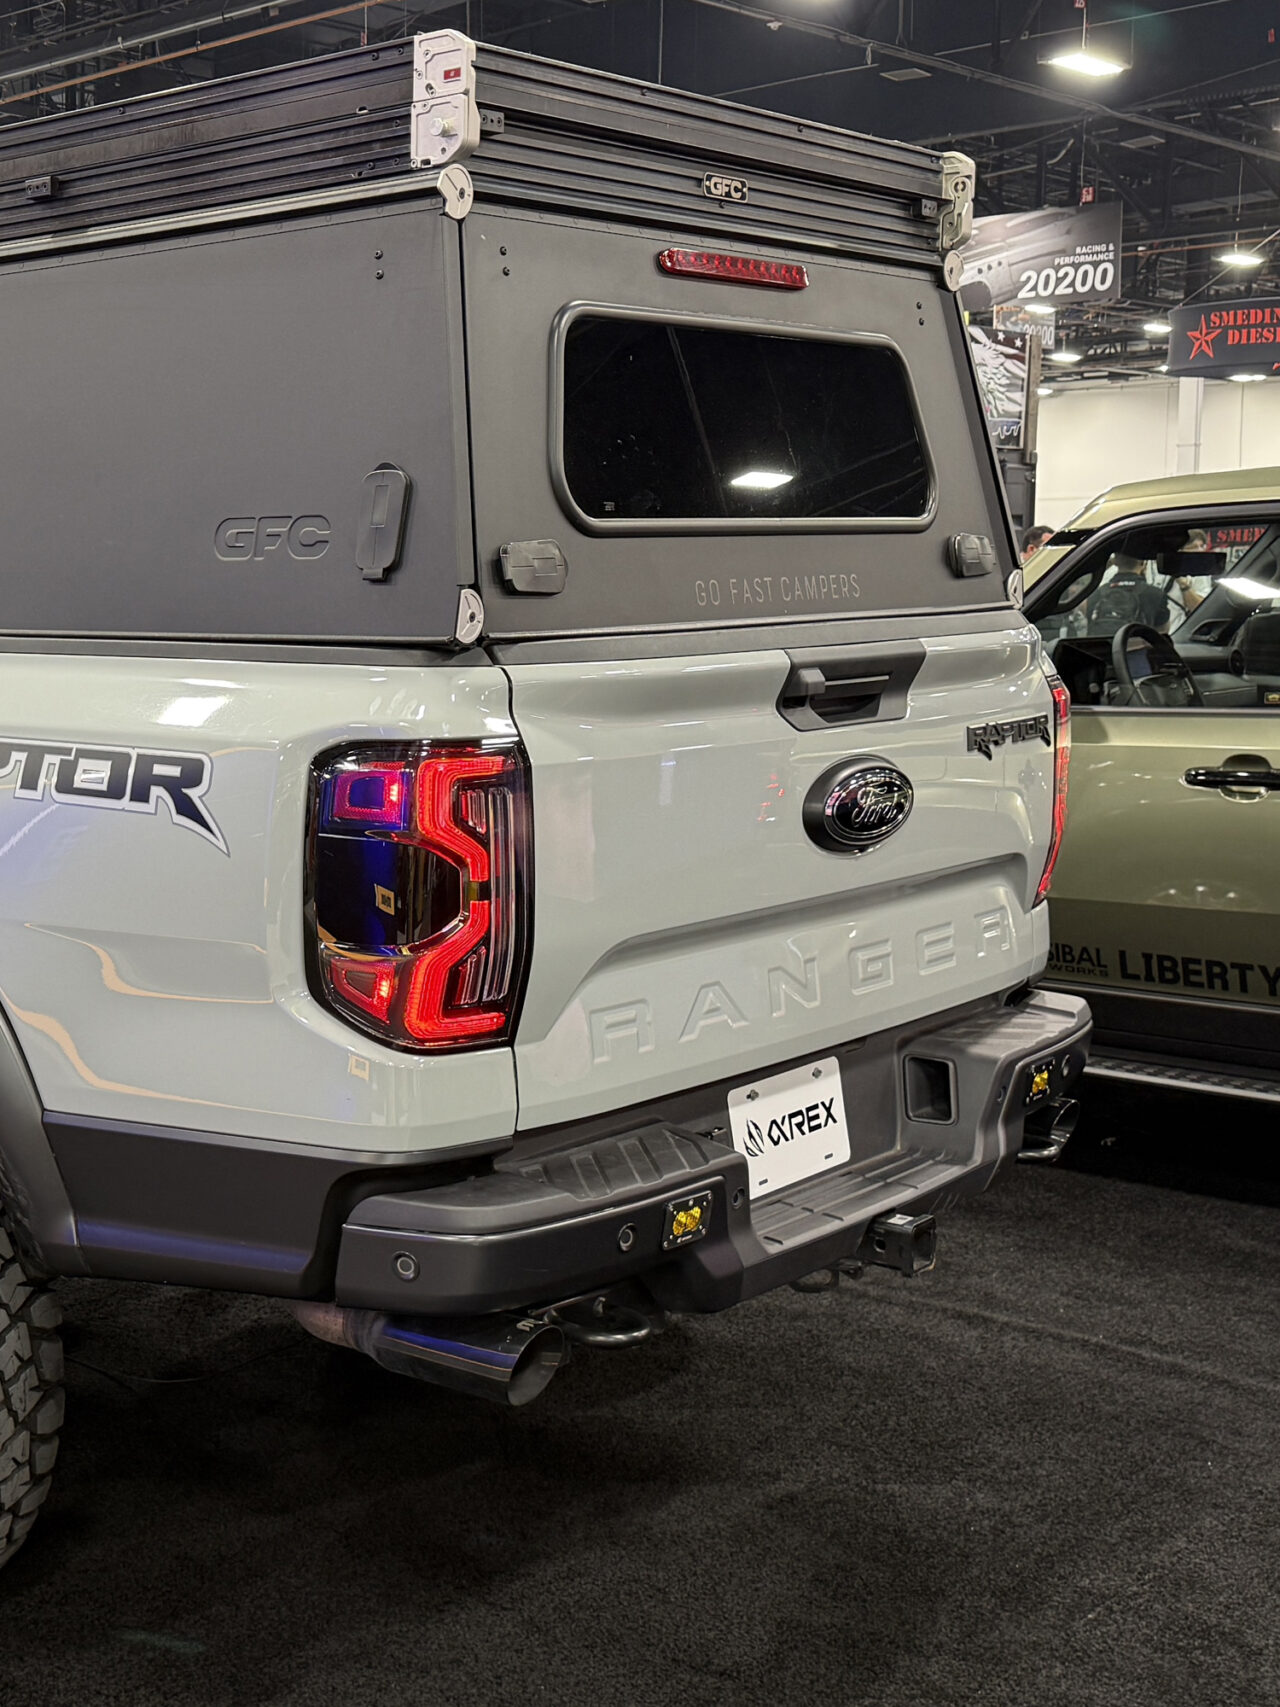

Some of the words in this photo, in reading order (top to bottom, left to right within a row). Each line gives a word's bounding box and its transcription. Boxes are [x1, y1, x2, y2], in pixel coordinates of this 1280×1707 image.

[710, 176, 743, 199] GFC
[1054, 252, 1115, 266] PERFORMANCE
[1075, 244, 1107, 254] RACING
[1017, 262, 1115, 299] 20200
[214, 514, 331, 561] GFC
[695, 579, 720, 606] GO
[729, 577, 772, 604] FAST
[780, 574, 861, 601] CAMPERS
[966, 713, 1051, 761] RAPTOR
[851, 785, 899, 828] Ford
[589, 906, 1013, 1064] RANGER
[1049, 963, 1109, 977] WORKS
[1118, 949, 1280, 997] LIBERTY
